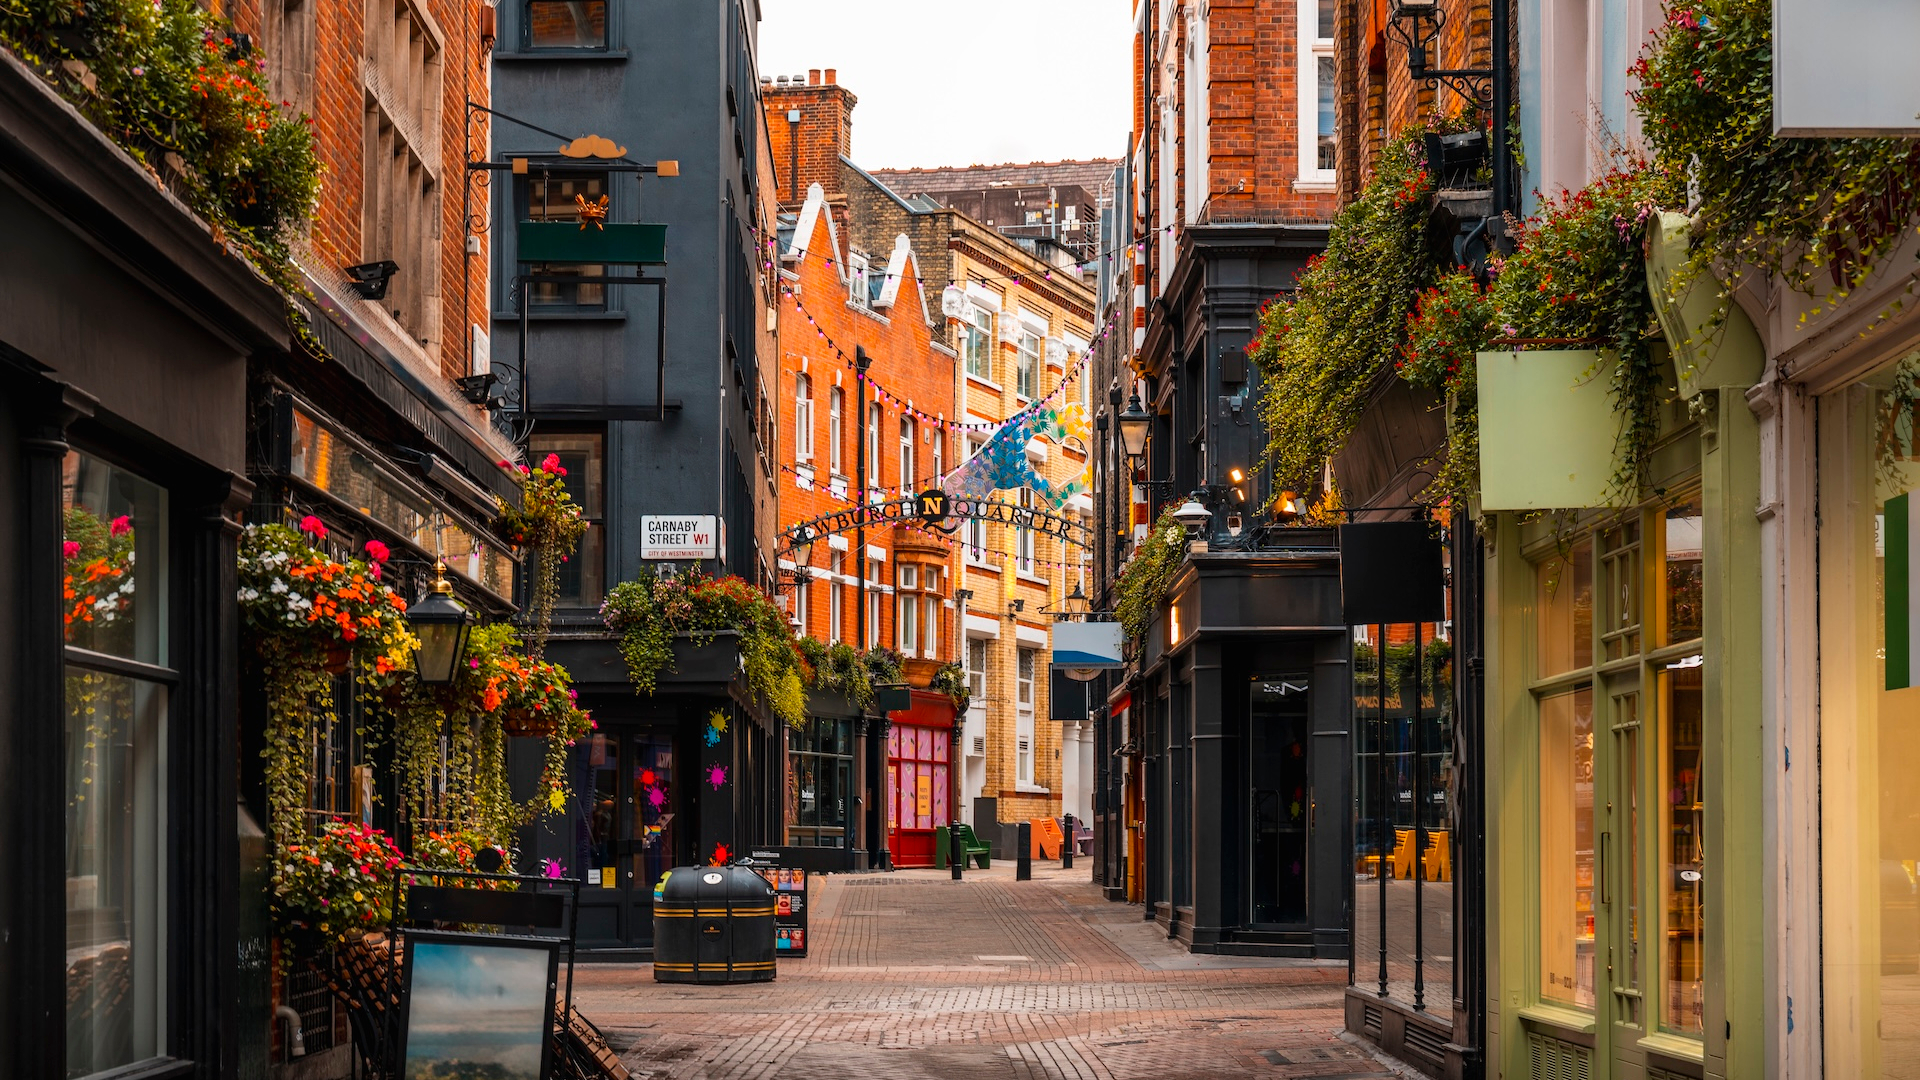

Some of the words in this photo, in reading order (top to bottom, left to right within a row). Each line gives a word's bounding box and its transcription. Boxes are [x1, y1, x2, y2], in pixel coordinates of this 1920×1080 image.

[648, 520, 698, 532] CARNABY
[793, 498, 914, 540] EWBURGH
[922, 497, 943, 515] N
[955, 501, 1071, 539] QUARTER
[649, 533, 688, 545] STREET
[693, 533, 709, 545] W1
[1622, 583, 1629, 621] 2
